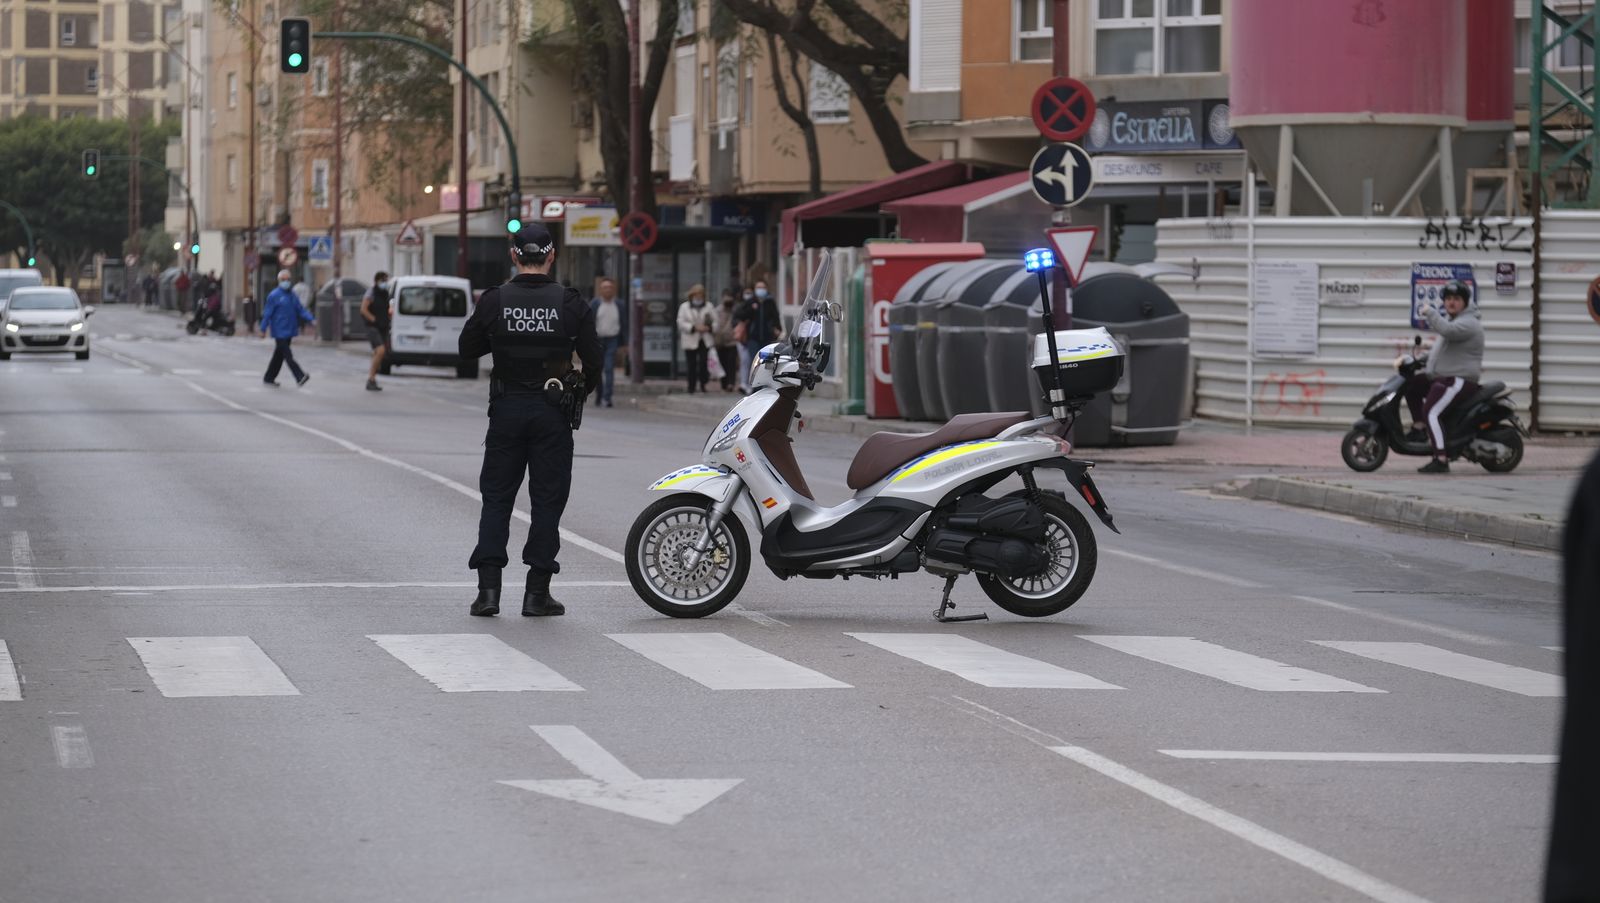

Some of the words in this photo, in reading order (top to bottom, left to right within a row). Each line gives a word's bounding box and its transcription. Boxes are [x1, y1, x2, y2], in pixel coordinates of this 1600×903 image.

[1103, 163, 1163, 176] DESAYUNOS
[503, 307, 559, 320] POLICIA
[507, 320, 555, 332] LOCAL
[722, 413, 741, 433] 092
[966, 450, 1002, 467] LOCAL
